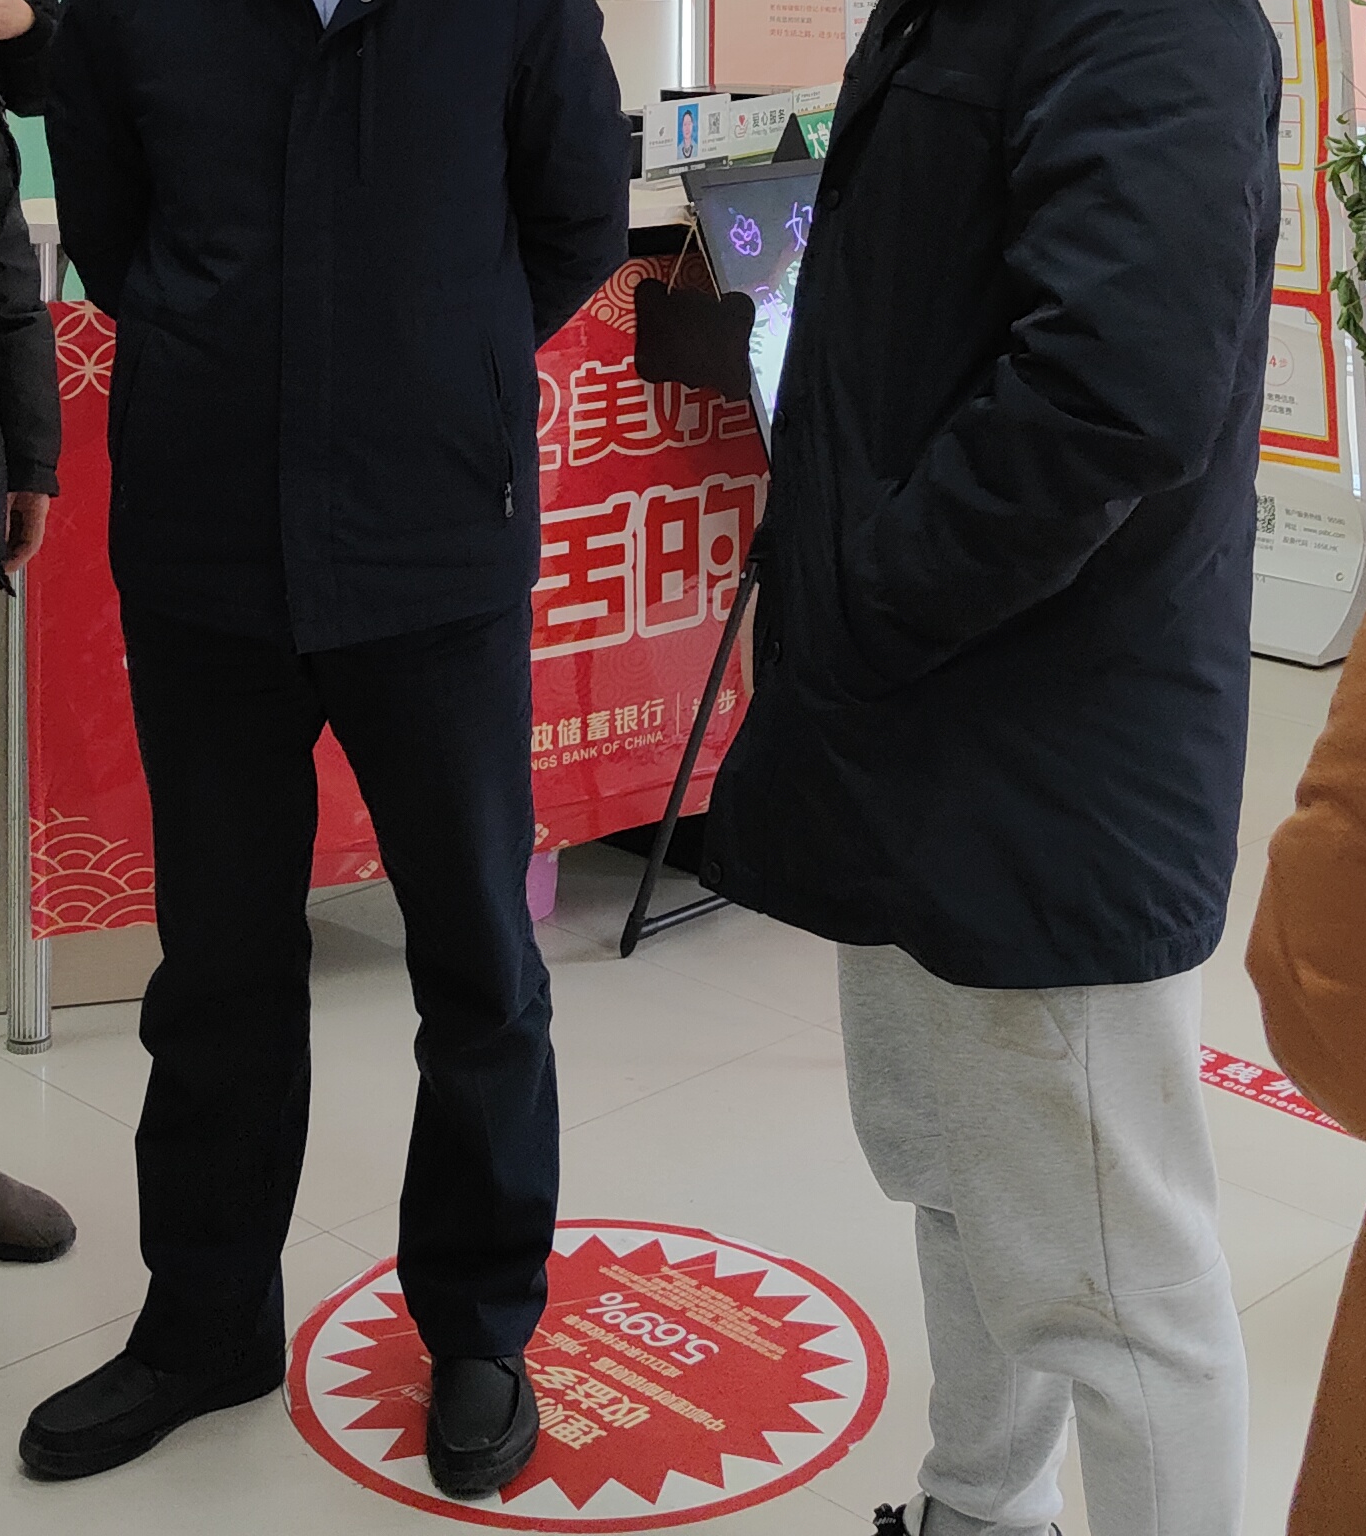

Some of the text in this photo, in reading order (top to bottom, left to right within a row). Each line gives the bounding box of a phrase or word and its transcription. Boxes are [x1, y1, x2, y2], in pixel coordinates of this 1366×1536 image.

[563, 747, 597, 764] BANK
[603, 739, 621, 756] OF
[625, 730, 664, 750] CHINA
[1222, 1080, 1257, 1096] one
[1258, 1093, 1316, 1117] meter
[585, 1291, 720, 1365] 5.69%
